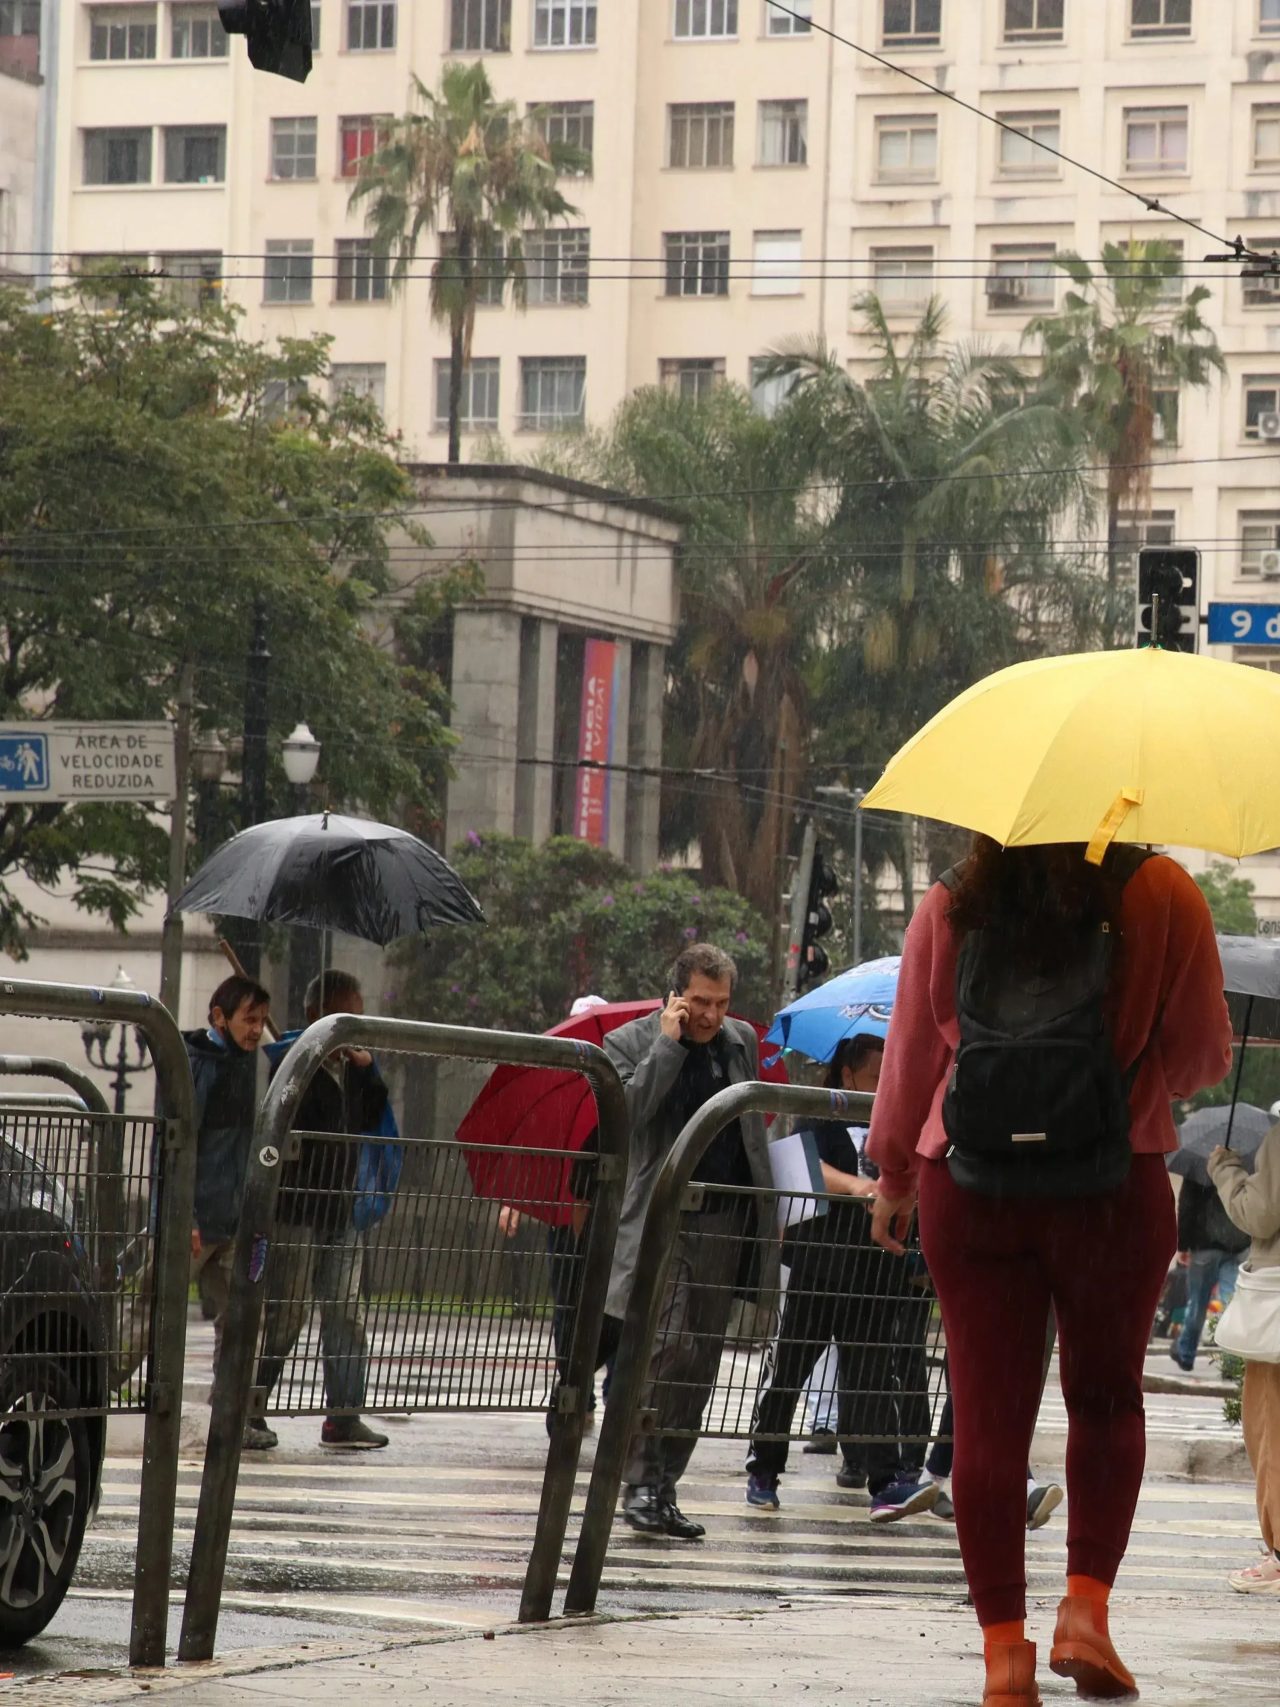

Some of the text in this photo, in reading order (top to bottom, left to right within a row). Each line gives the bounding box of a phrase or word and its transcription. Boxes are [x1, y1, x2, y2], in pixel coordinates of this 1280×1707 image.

[1230, 610, 1252, 639] 9
[126, 735, 148, 749] DE
[60, 754, 164, 769] VELOCIDADE
[72, 774, 154, 788] REDUZIDA
